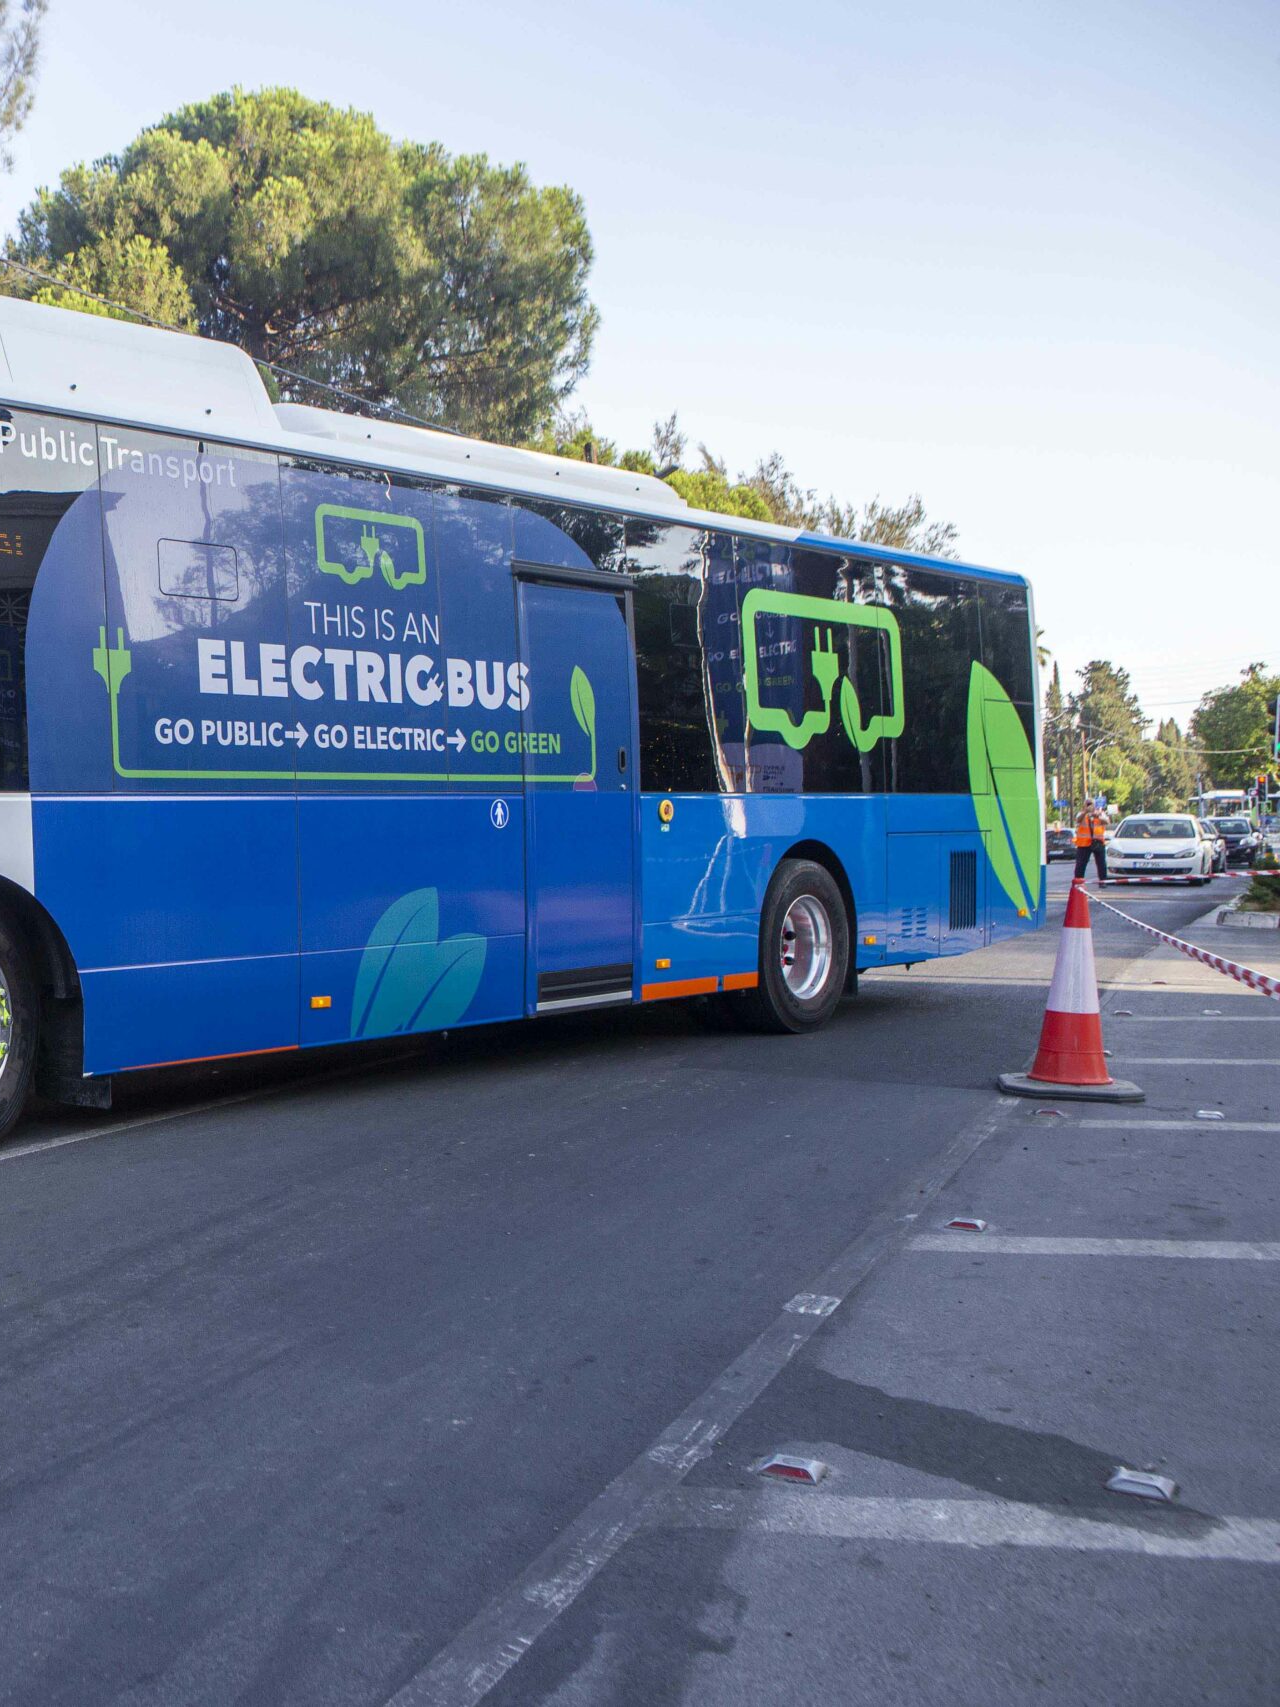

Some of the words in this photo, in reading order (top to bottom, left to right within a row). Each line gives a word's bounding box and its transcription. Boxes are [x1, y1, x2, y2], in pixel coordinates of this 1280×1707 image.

[100, 436, 236, 488] Transport
[303, 601, 366, 639] THIS
[374, 609, 395, 641] IS
[403, 613, 440, 645] AN
[197, 638, 439, 707] ELECTRIC
[446, 657, 530, 711] BUS
[154, 717, 194, 745] GO
[201, 719, 284, 747] PUBLIC
[314, 723, 348, 749] GO
[353, 725, 445, 752] ELECTRIC
[470, 730, 501, 754] GO
[504, 730, 561, 755] GREEN
